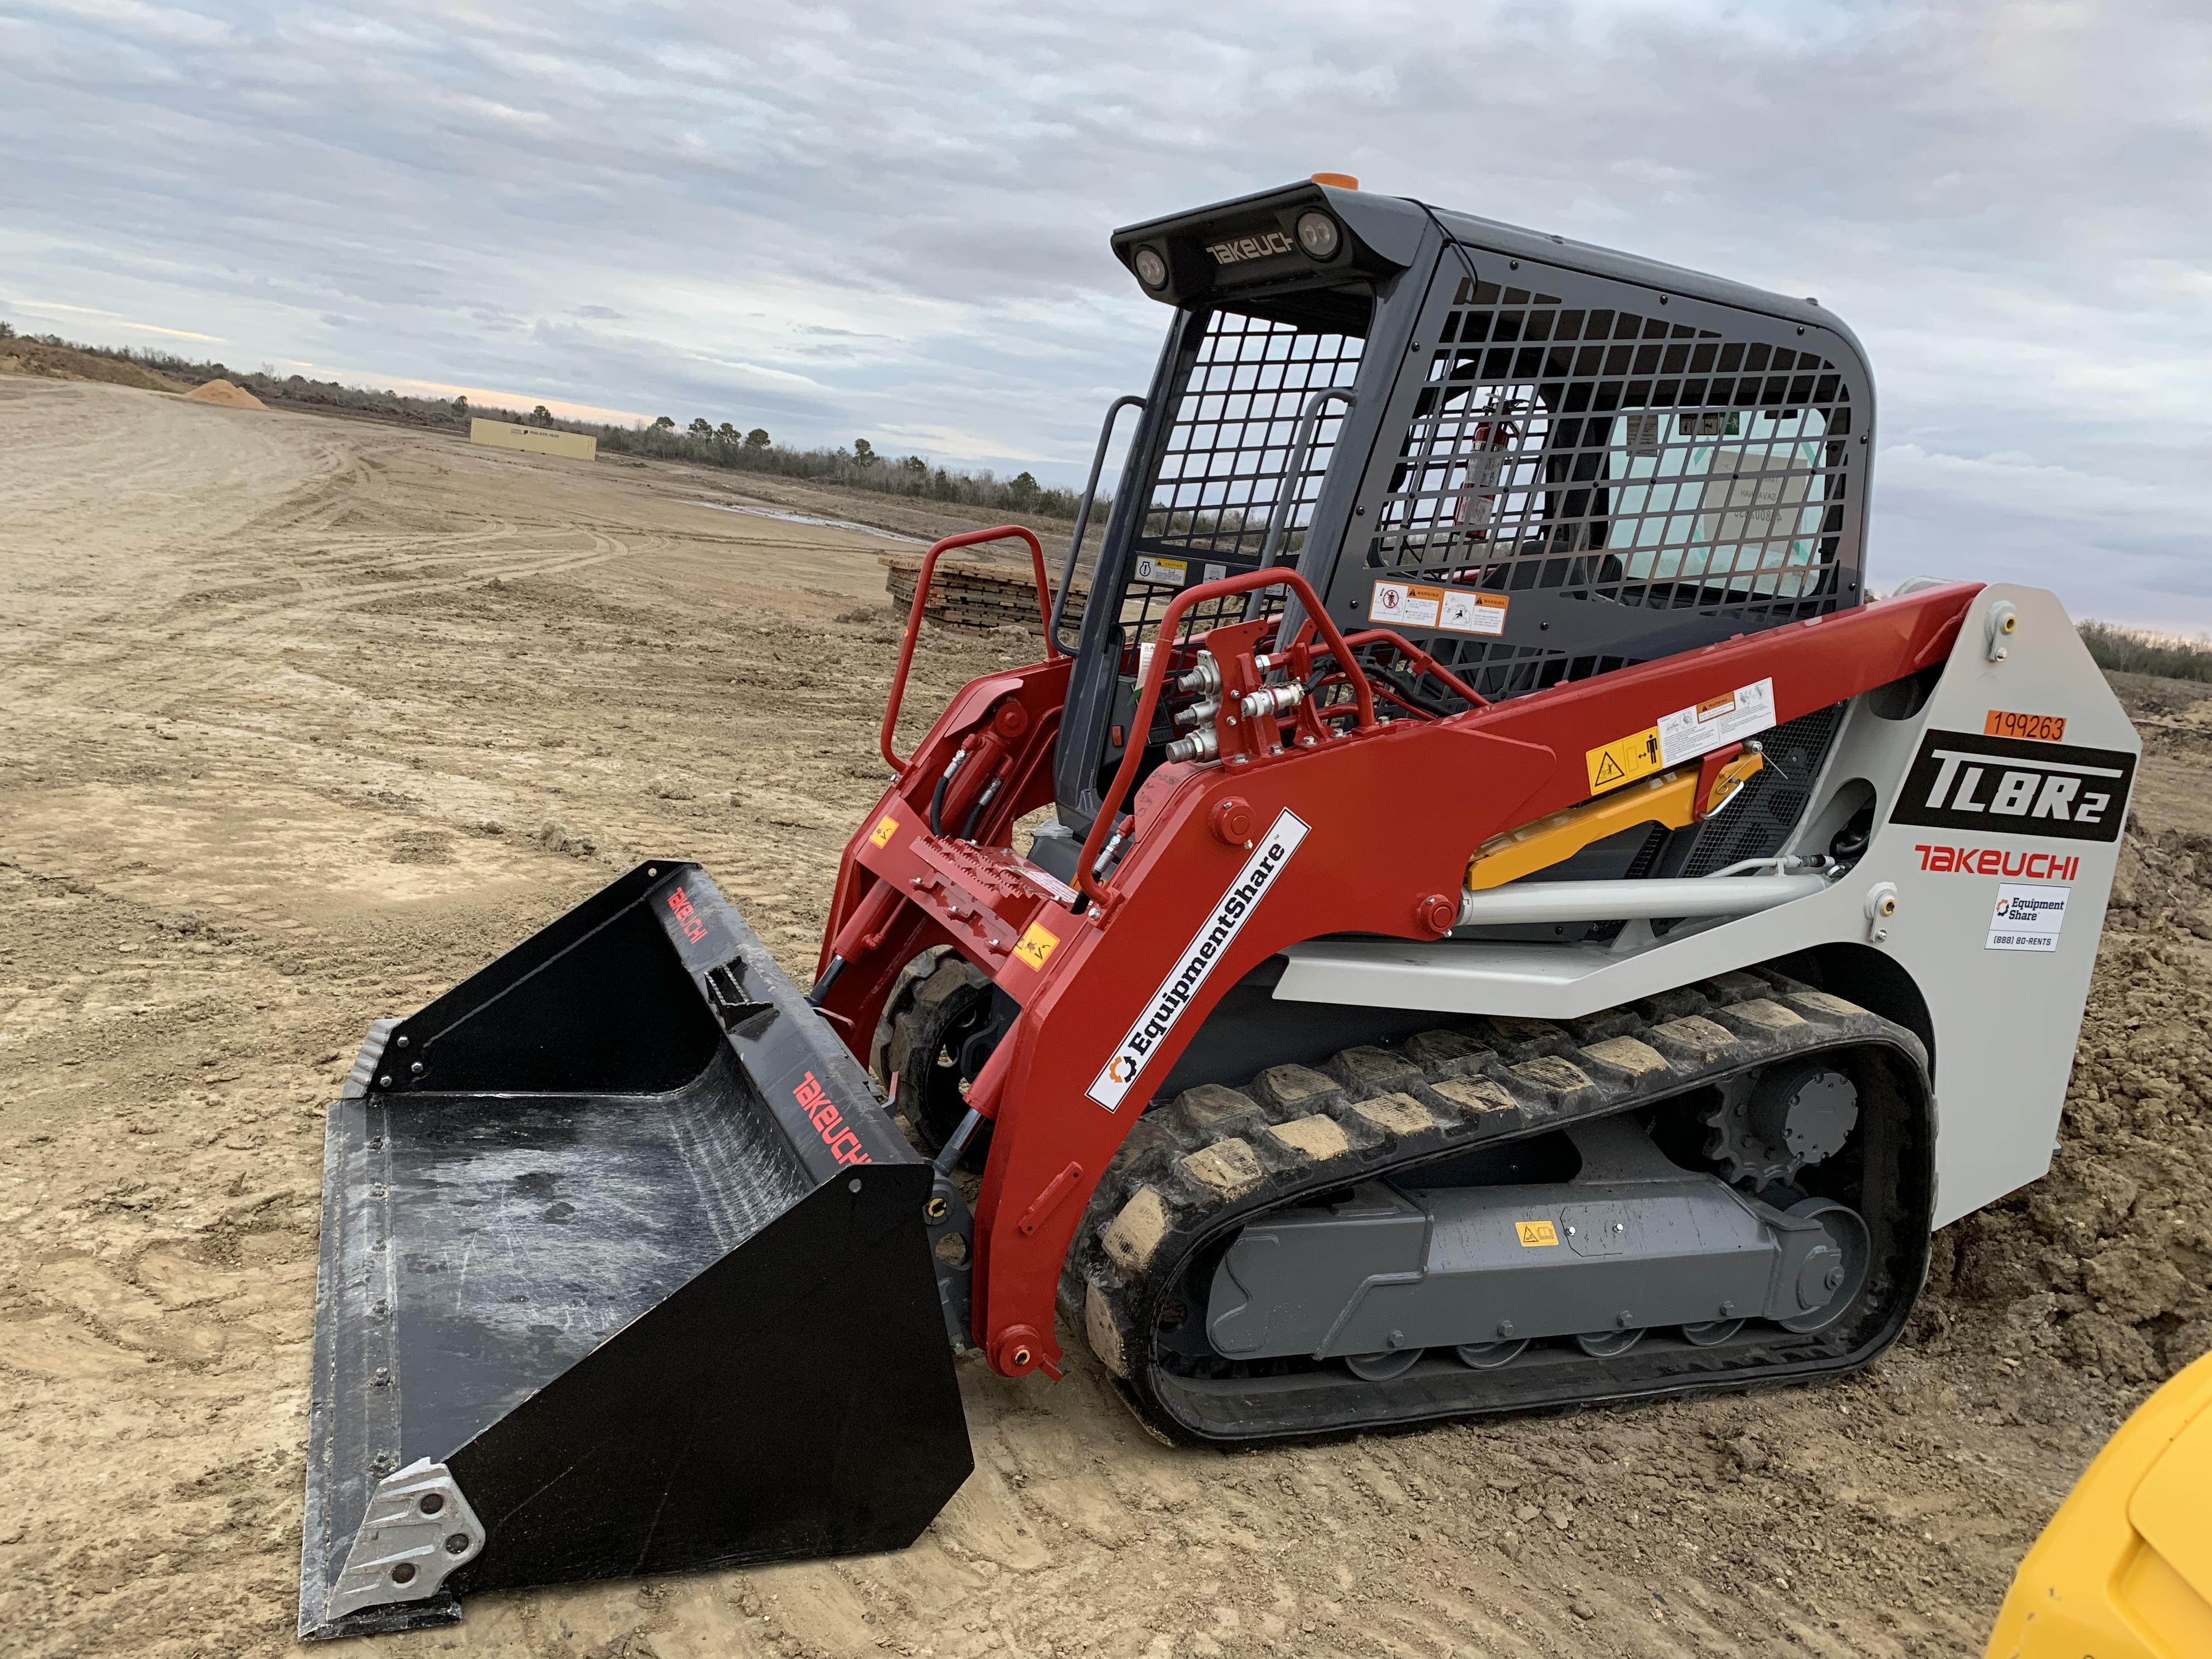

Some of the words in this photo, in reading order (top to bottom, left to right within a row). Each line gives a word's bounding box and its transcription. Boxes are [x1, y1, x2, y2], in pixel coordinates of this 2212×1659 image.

[1994, 711, 2064, 741] 199263
[1914, 844, 2080, 881] TAKEUCHI
[2011, 897, 2065, 911] Equipment
[667, 886, 708, 945] TAKEUCHI
[2008, 910, 2038, 921] Share
[1993, 935, 2015, 945] (888)
[2016, 936, 2052, 946] 80-RENTS
